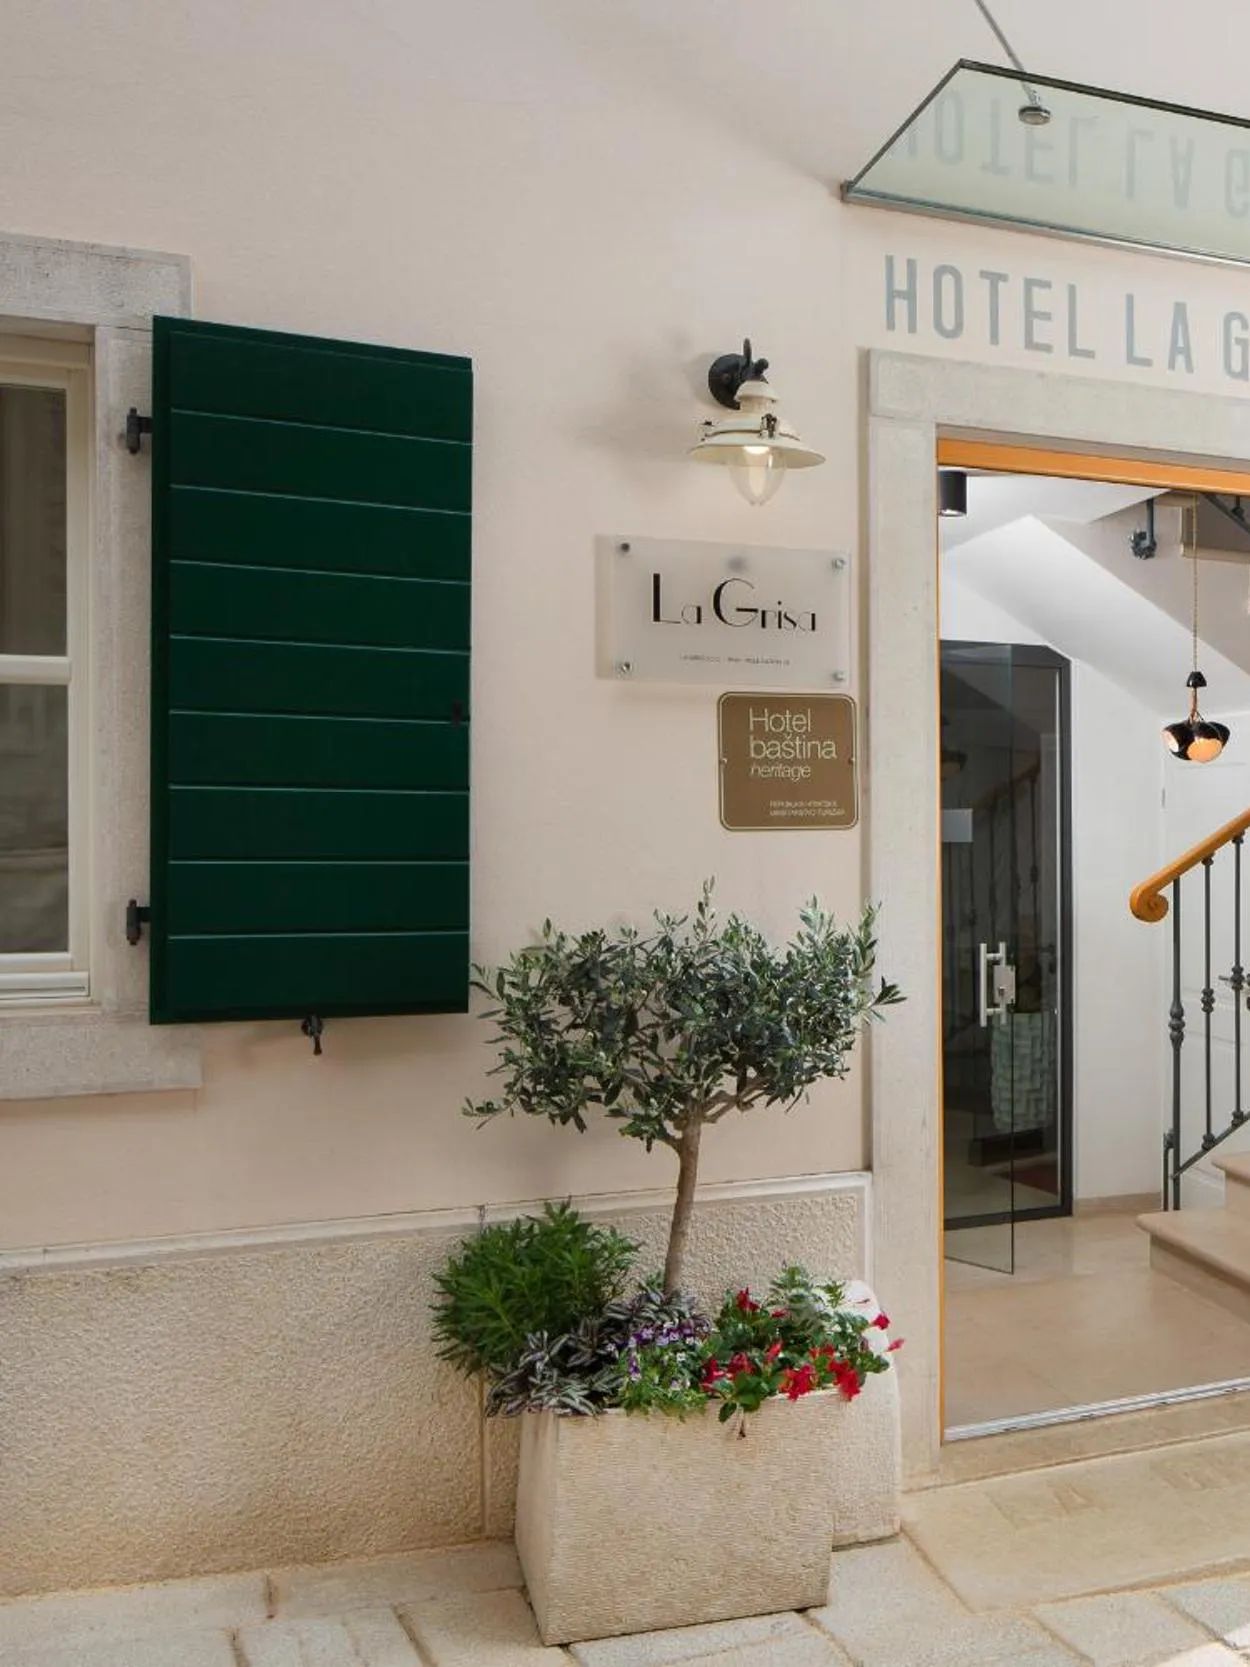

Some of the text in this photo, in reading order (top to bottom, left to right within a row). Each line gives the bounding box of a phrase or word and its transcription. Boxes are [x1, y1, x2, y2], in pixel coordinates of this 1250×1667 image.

[885, 254, 1096, 360] HOTEL
[1125, 292, 1195, 375] LA
[652, 572, 816, 632] La Grisa
[749, 707, 811, 733] Hotel
[749, 733, 838, 760] baština
[749, 763, 812, 782] heritage
